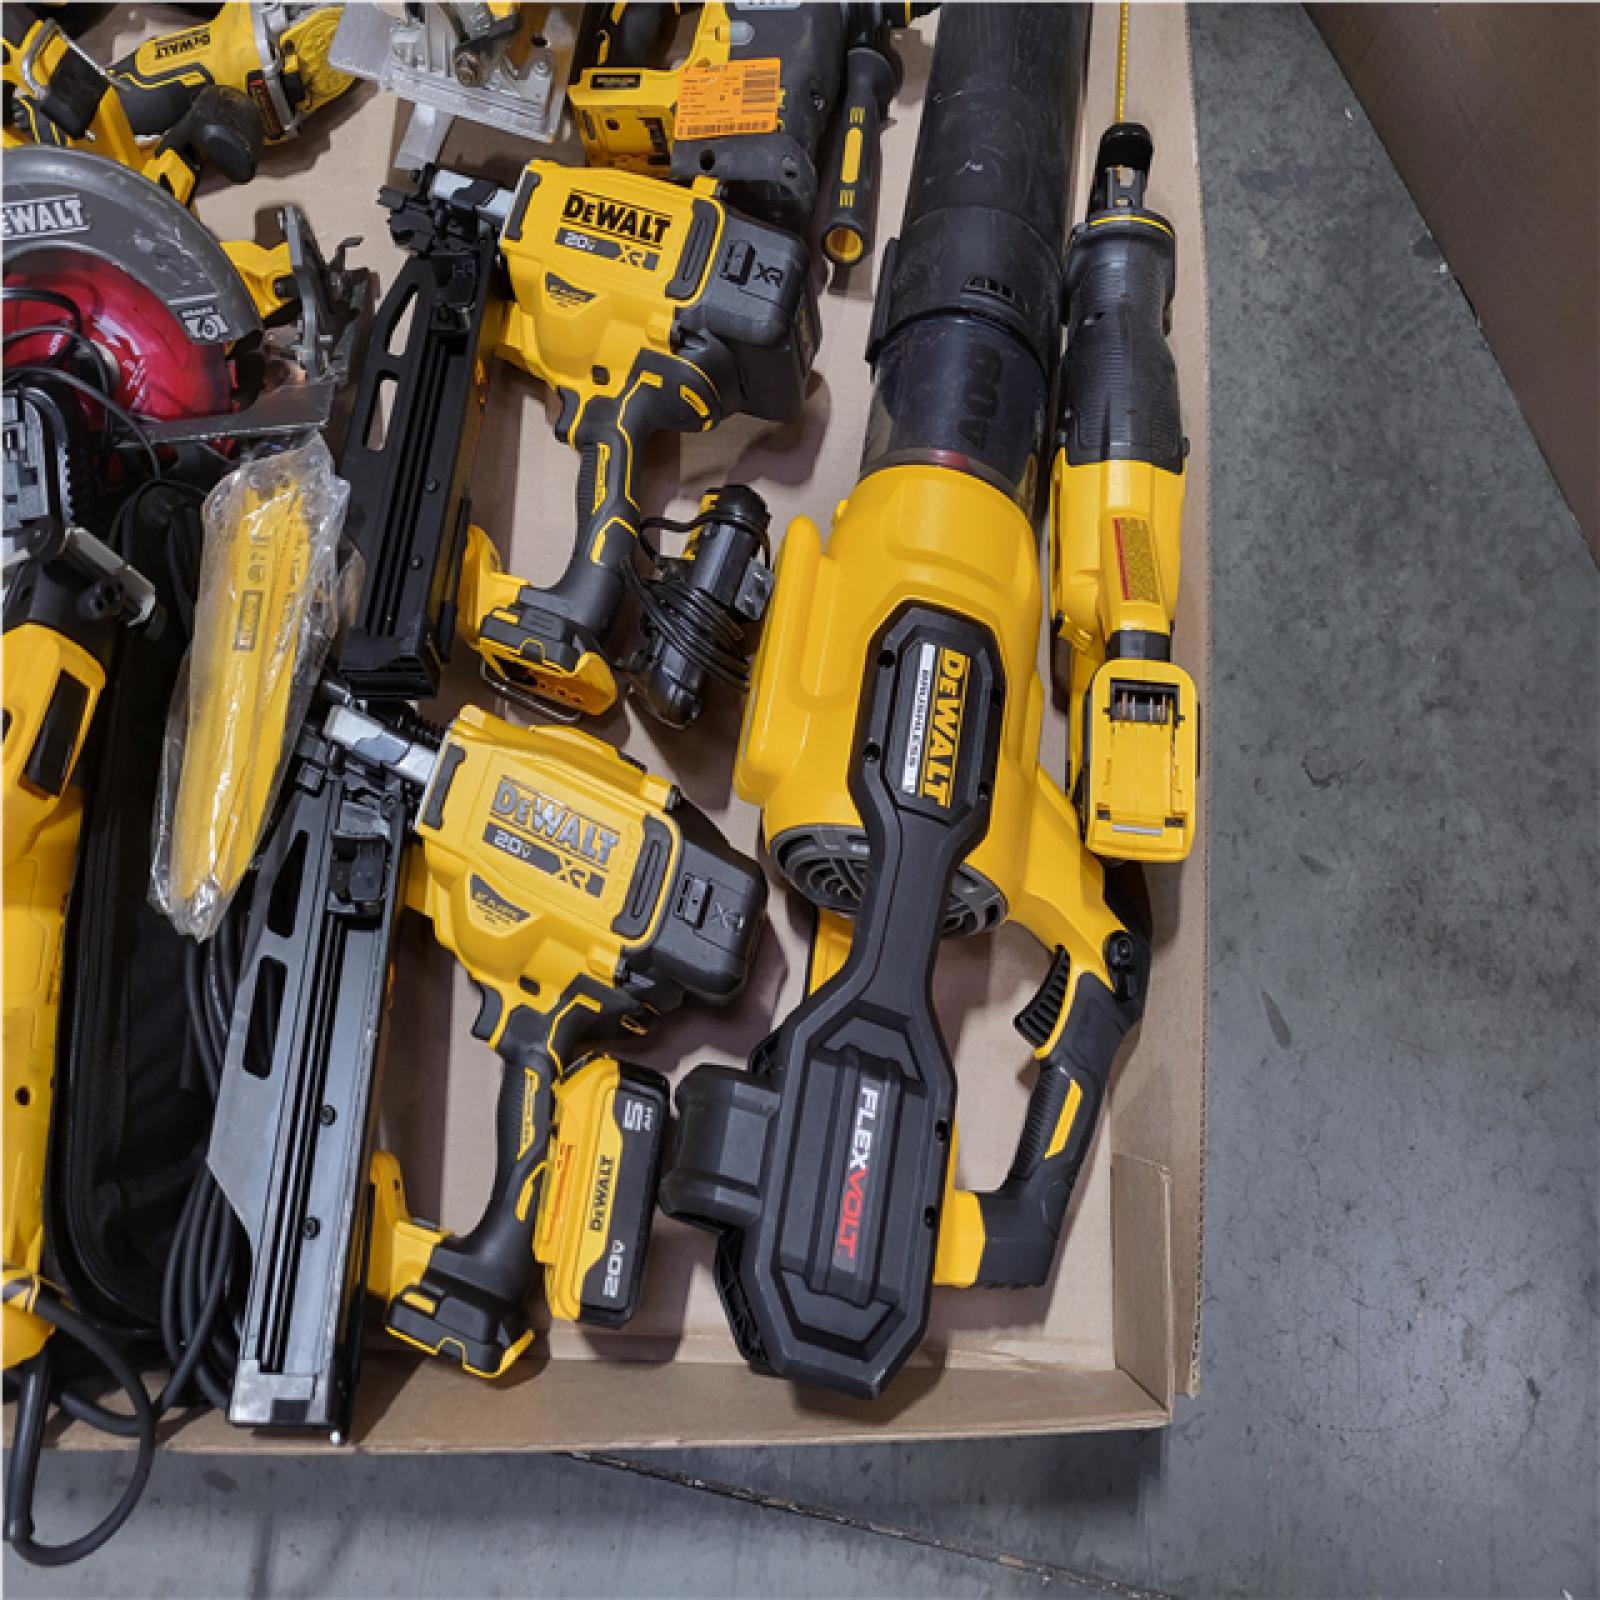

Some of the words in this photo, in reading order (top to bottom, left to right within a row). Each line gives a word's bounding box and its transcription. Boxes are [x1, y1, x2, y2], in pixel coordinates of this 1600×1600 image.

[562, 194, 671, 243] DEWALT
[924, 650, 967, 807] DEWALT
[492, 779, 620, 865] DEWALT
[590, 1155, 615, 1231] DEWALT
[838, 1087, 879, 1259] FLEXVOLT
